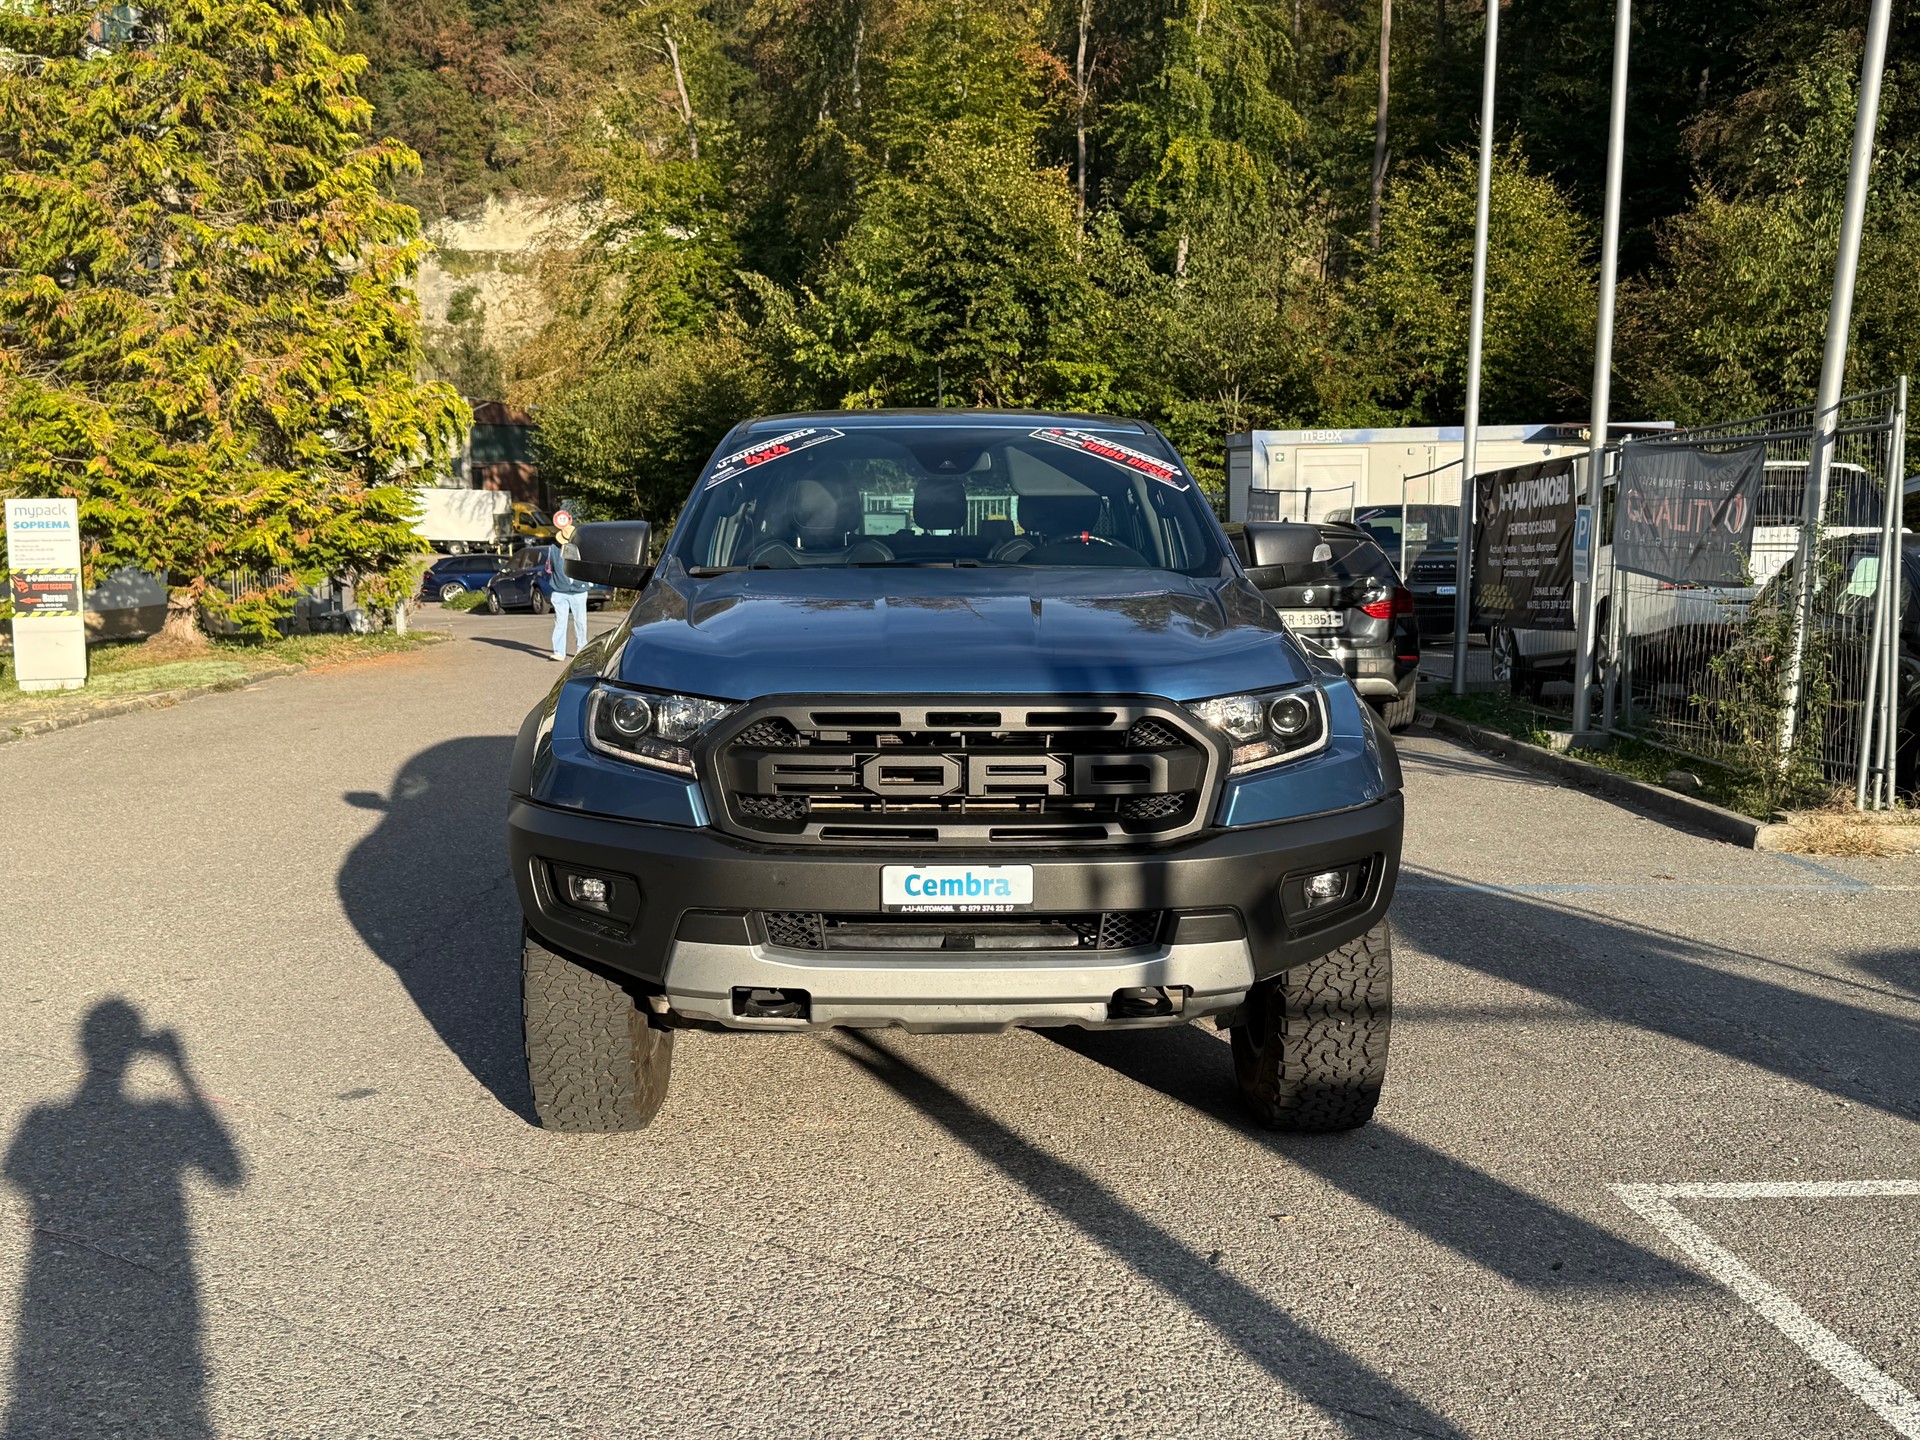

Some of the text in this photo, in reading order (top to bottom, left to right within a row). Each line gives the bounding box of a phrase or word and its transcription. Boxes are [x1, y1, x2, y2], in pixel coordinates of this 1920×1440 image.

[1081, 440, 1127, 461] TURBO
[1126, 456, 1175, 481] DIESEL
[14, 503, 67, 518] mypack
[13, 521, 71, 529] SOPREMA
[1507, 519, 1556, 536] CENTRE OCCASION
[1578, 516, 1588, 545] P
[757, 752, 1169, 796] FORD
[905, 872, 1011, 897] Cembra
